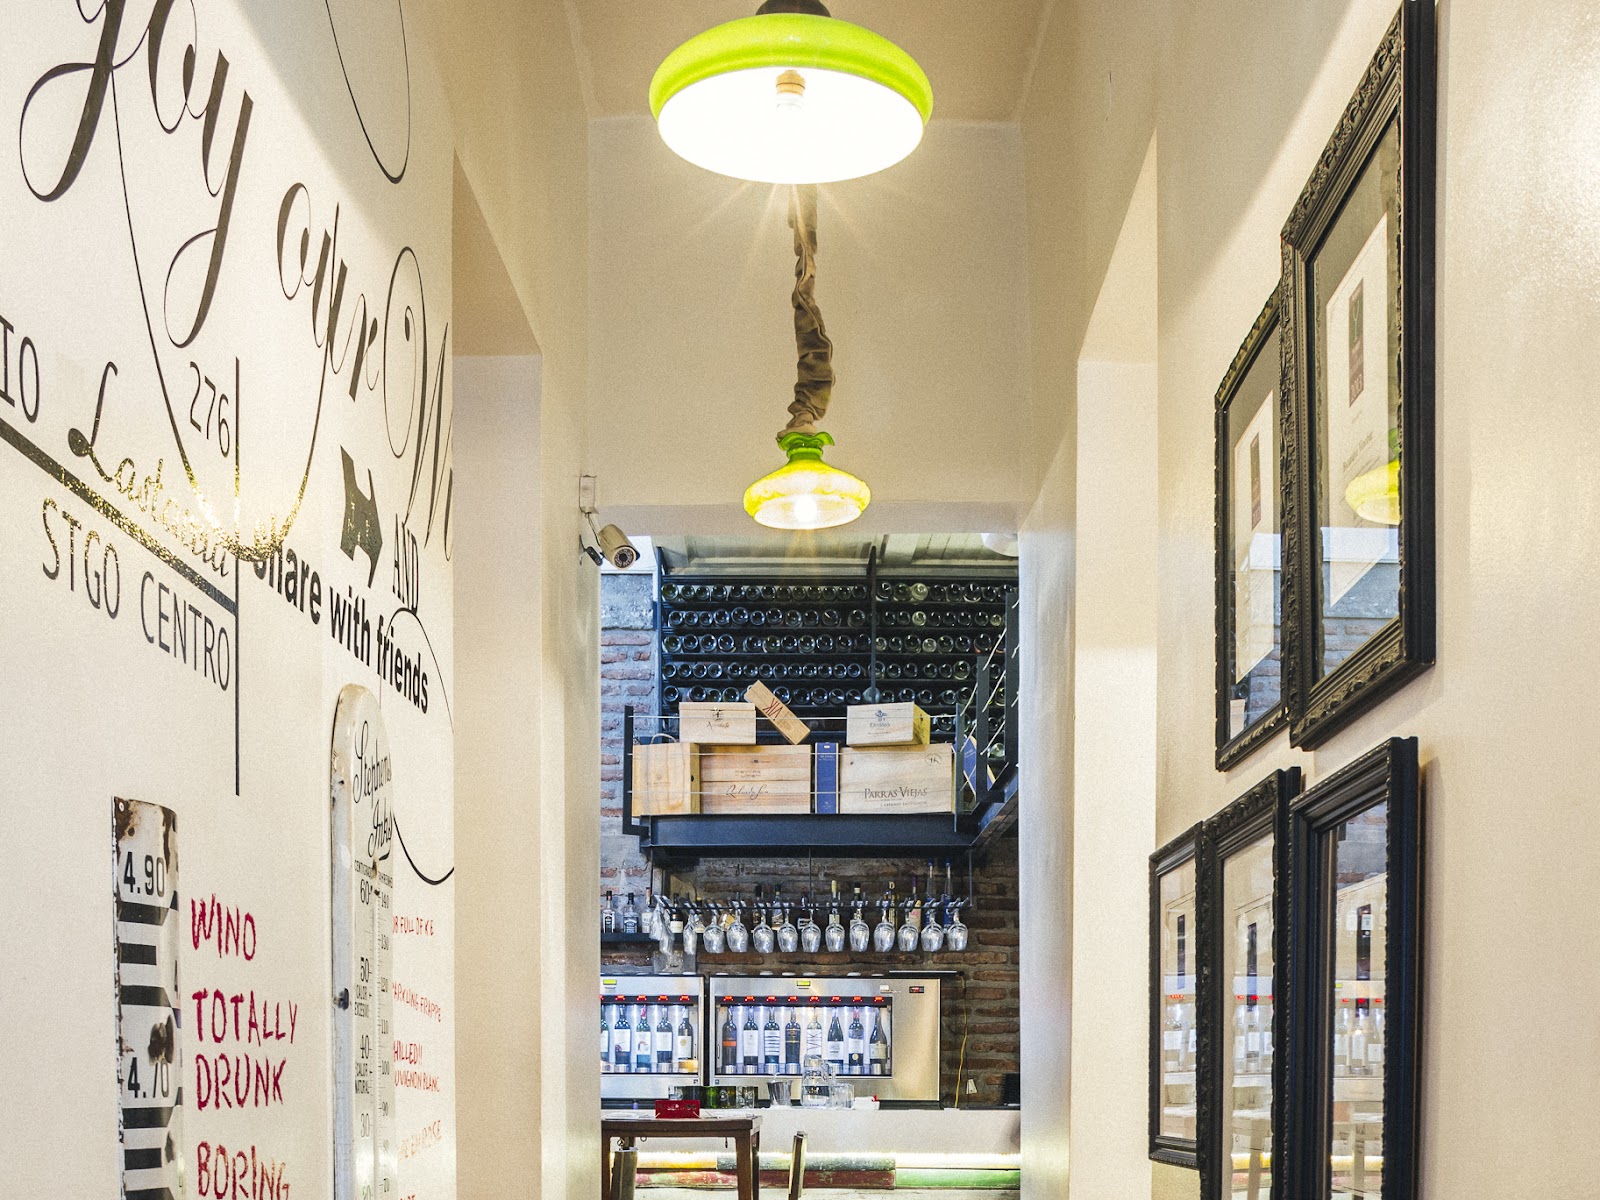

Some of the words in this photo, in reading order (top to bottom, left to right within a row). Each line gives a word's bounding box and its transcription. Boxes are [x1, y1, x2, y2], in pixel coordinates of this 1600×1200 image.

[20, 0, 253, 348] joy
[189, 361, 231, 458] 276
[43, 496, 120, 620] STGO
[140, 571, 230, 691] CENTRO
[329, 584, 371, 667] with
[376, 614, 429, 714] friends
[864, 788, 898, 800] PARRAS
[899, 786, 928, 799] VIEJAS
[123, 851, 165, 898] 4.90
[191, 893, 257, 961] WINO
[400, 916, 414, 934] FULL
[360, 957, 370, 983] 50
[192, 988, 298, 1047] TOTALLY
[360, 1035, 370, 1060] 40
[393, 1040, 423, 1066] HILLED!!
[196, 1053, 287, 1111] DRUNK
[360, 1112, 370, 1138] 30
